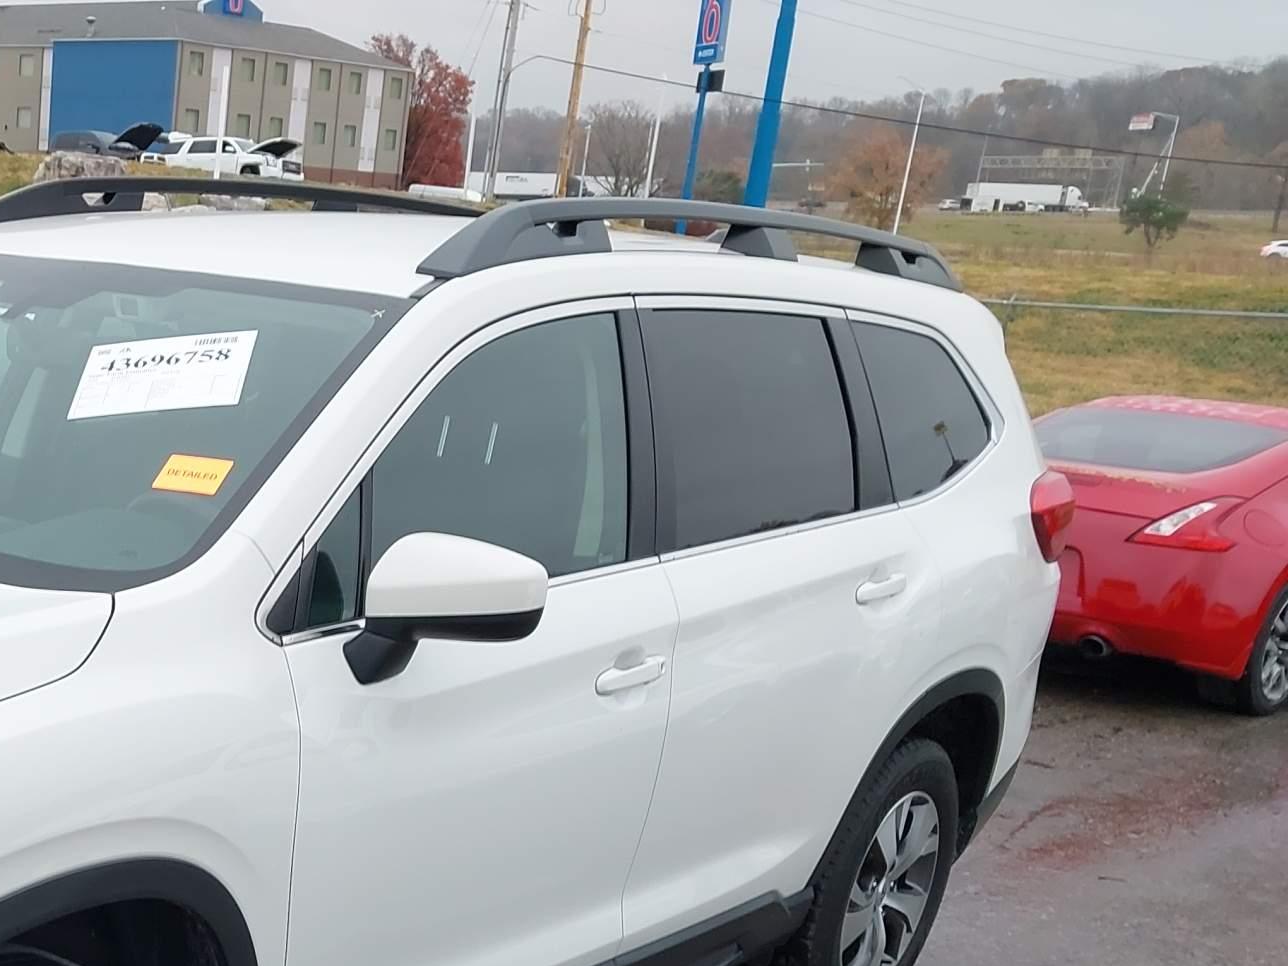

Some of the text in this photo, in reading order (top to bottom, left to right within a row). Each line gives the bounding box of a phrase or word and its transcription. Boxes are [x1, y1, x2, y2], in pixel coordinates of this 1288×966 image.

[702, 0, 720, 45] 6
[100, 347, 232, 373] 43696758
[167, 467, 218, 481] DETAILED
